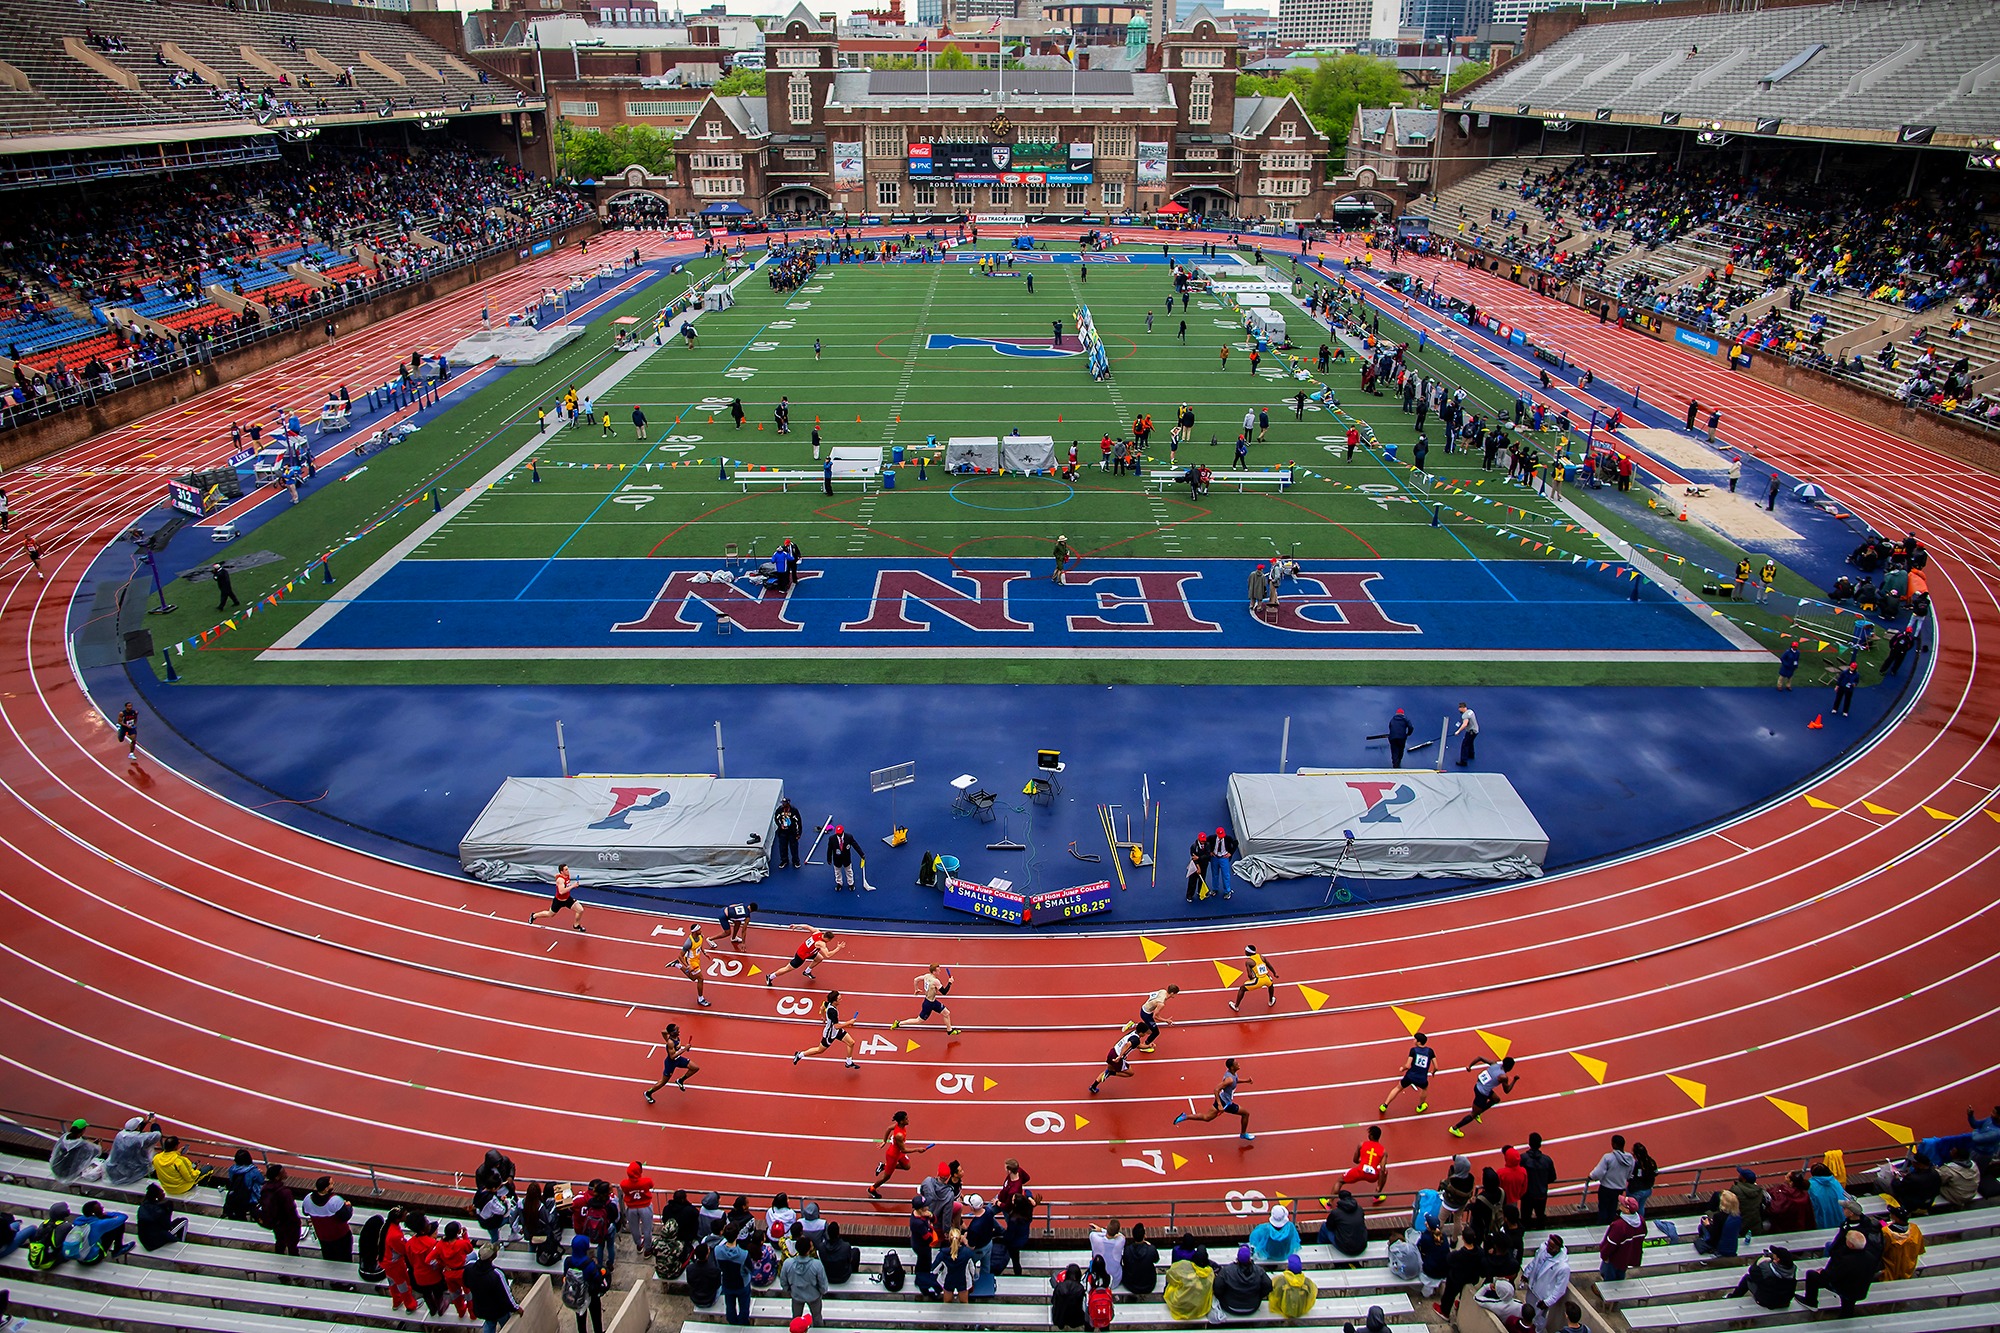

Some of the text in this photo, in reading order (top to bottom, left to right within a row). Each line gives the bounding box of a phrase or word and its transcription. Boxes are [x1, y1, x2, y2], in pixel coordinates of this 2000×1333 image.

[920, 136, 1058, 144] FRANKLIN FIELD
[695, 397, 734, 411] 30
[659, 435, 704, 451] 20
[176, 488, 192, 503] 312
[612, 484, 664, 504] 10
[1358, 484, 1412, 504] 10
[958, 888, 994, 903] SMALLS
[960, 881, 975, 891] HIGH
[976, 885, 992, 896] JUMP
[994, 890, 1023, 902] COLLEGE
[1033, 883, 1109, 903] CM HIGH JUMP COLLEGE
[974, 902, 1021, 921] 6'08.25"
[1035, 895, 1082, 910] 4 SMALLS
[1064, 898, 1111, 917] 6'08.25"
[651, 924, 685, 937] 1
[706, 958, 743, 977] 2
[776, 996, 813, 1016] 3
[859, 1034, 898, 1055] 4
[935, 1072, 975, 1094] 5
[1025, 1110, 1066, 1134] 6
[1121, 1150, 1166, 1175] 7
[1225, 1190, 1269, 1218] 8
